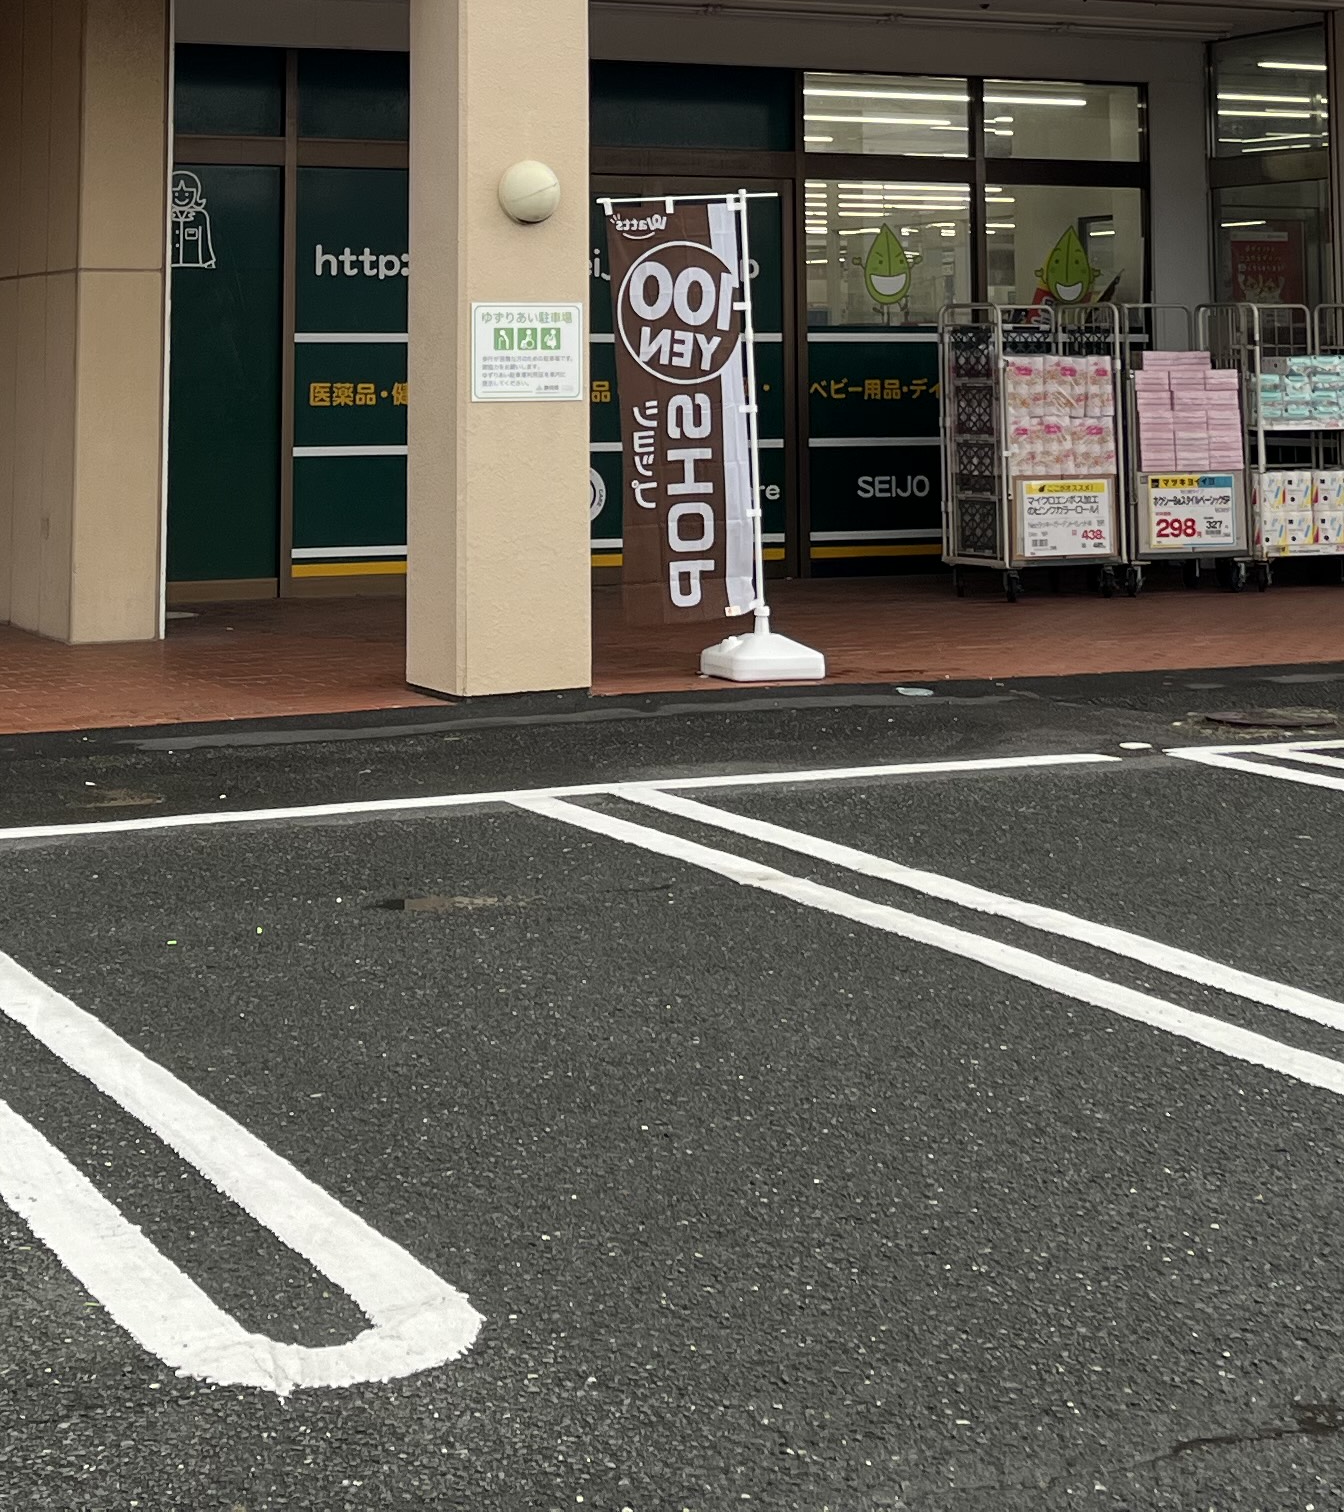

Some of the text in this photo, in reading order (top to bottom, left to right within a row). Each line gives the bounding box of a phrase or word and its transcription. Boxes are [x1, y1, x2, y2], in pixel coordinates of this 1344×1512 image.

[481, 311, 573, 324] ゆずりあい駐車場
[857, 475, 930, 498] SEIJO
